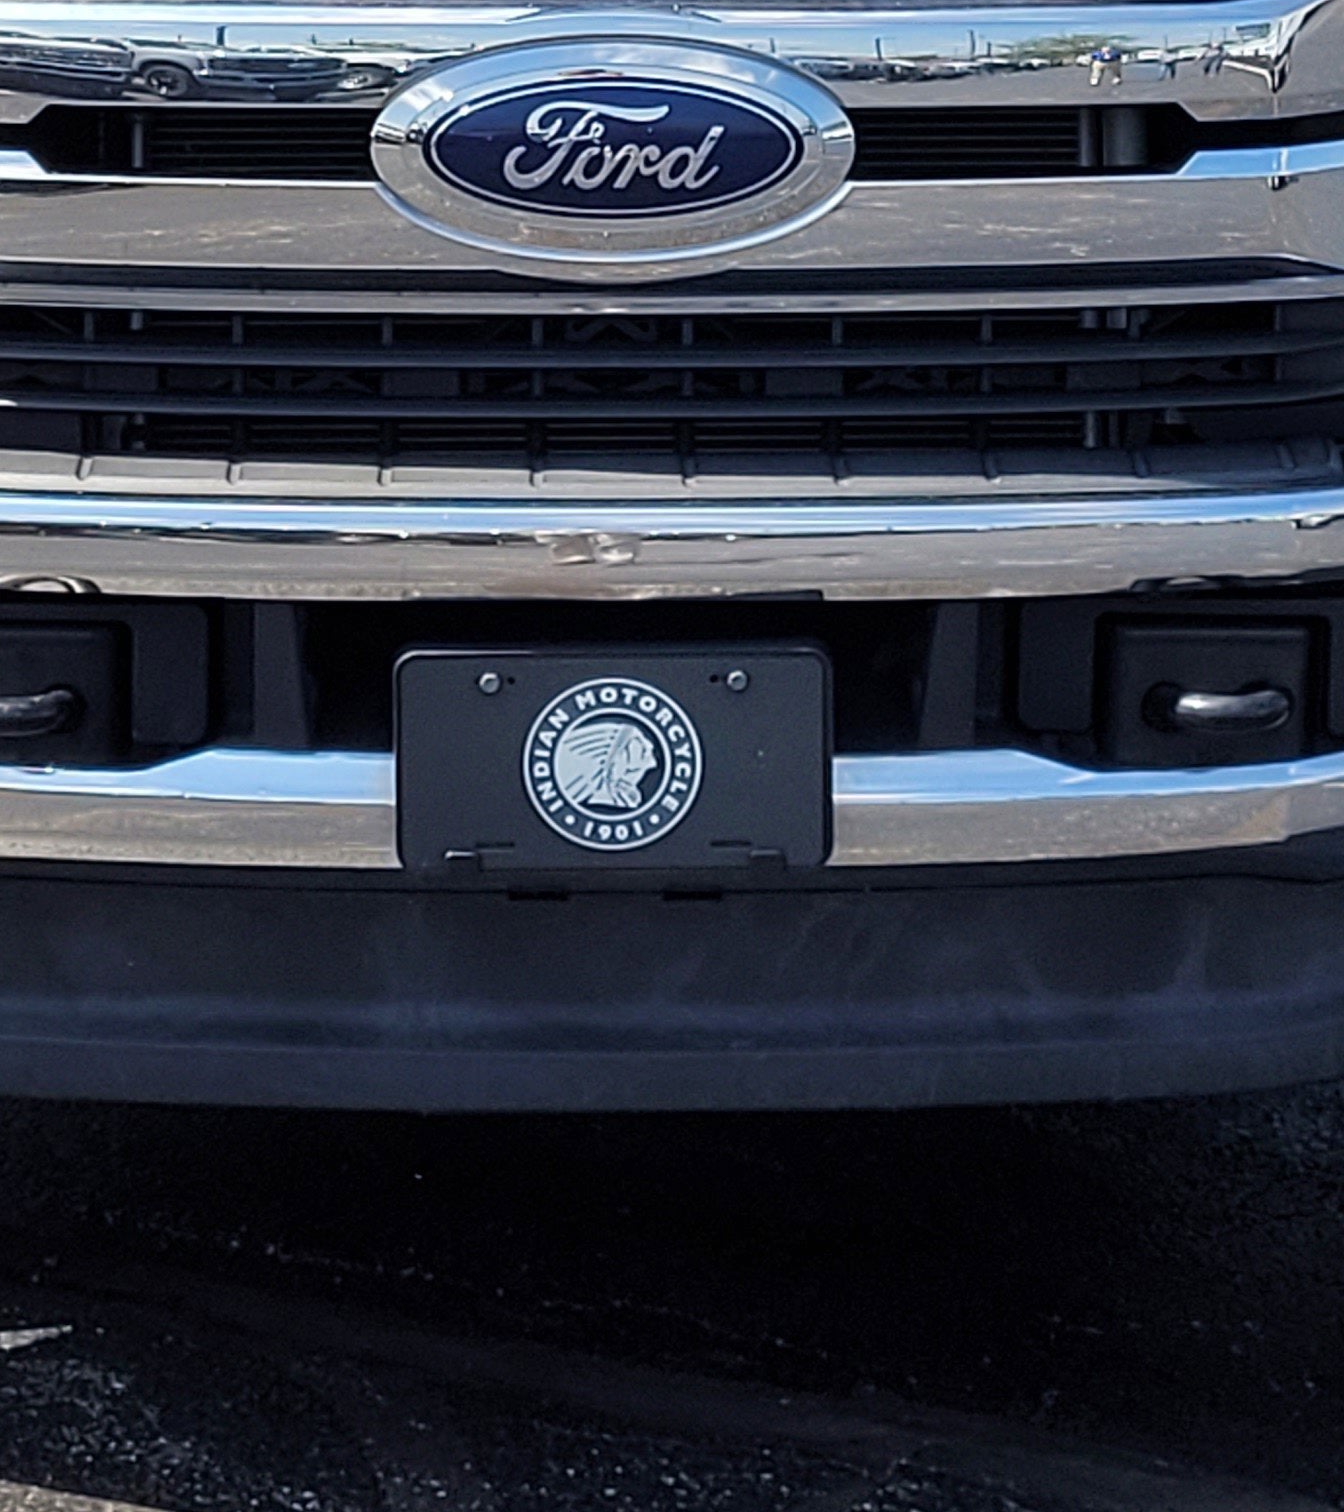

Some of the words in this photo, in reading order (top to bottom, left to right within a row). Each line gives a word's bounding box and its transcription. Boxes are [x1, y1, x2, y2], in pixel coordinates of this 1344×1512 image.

[502, 100, 724, 191] Ford
[532, 708, 570, 813] INDIAN
[574, 687, 691, 811] MOTORCYCLE
[584, 821, 643, 841] 1901
